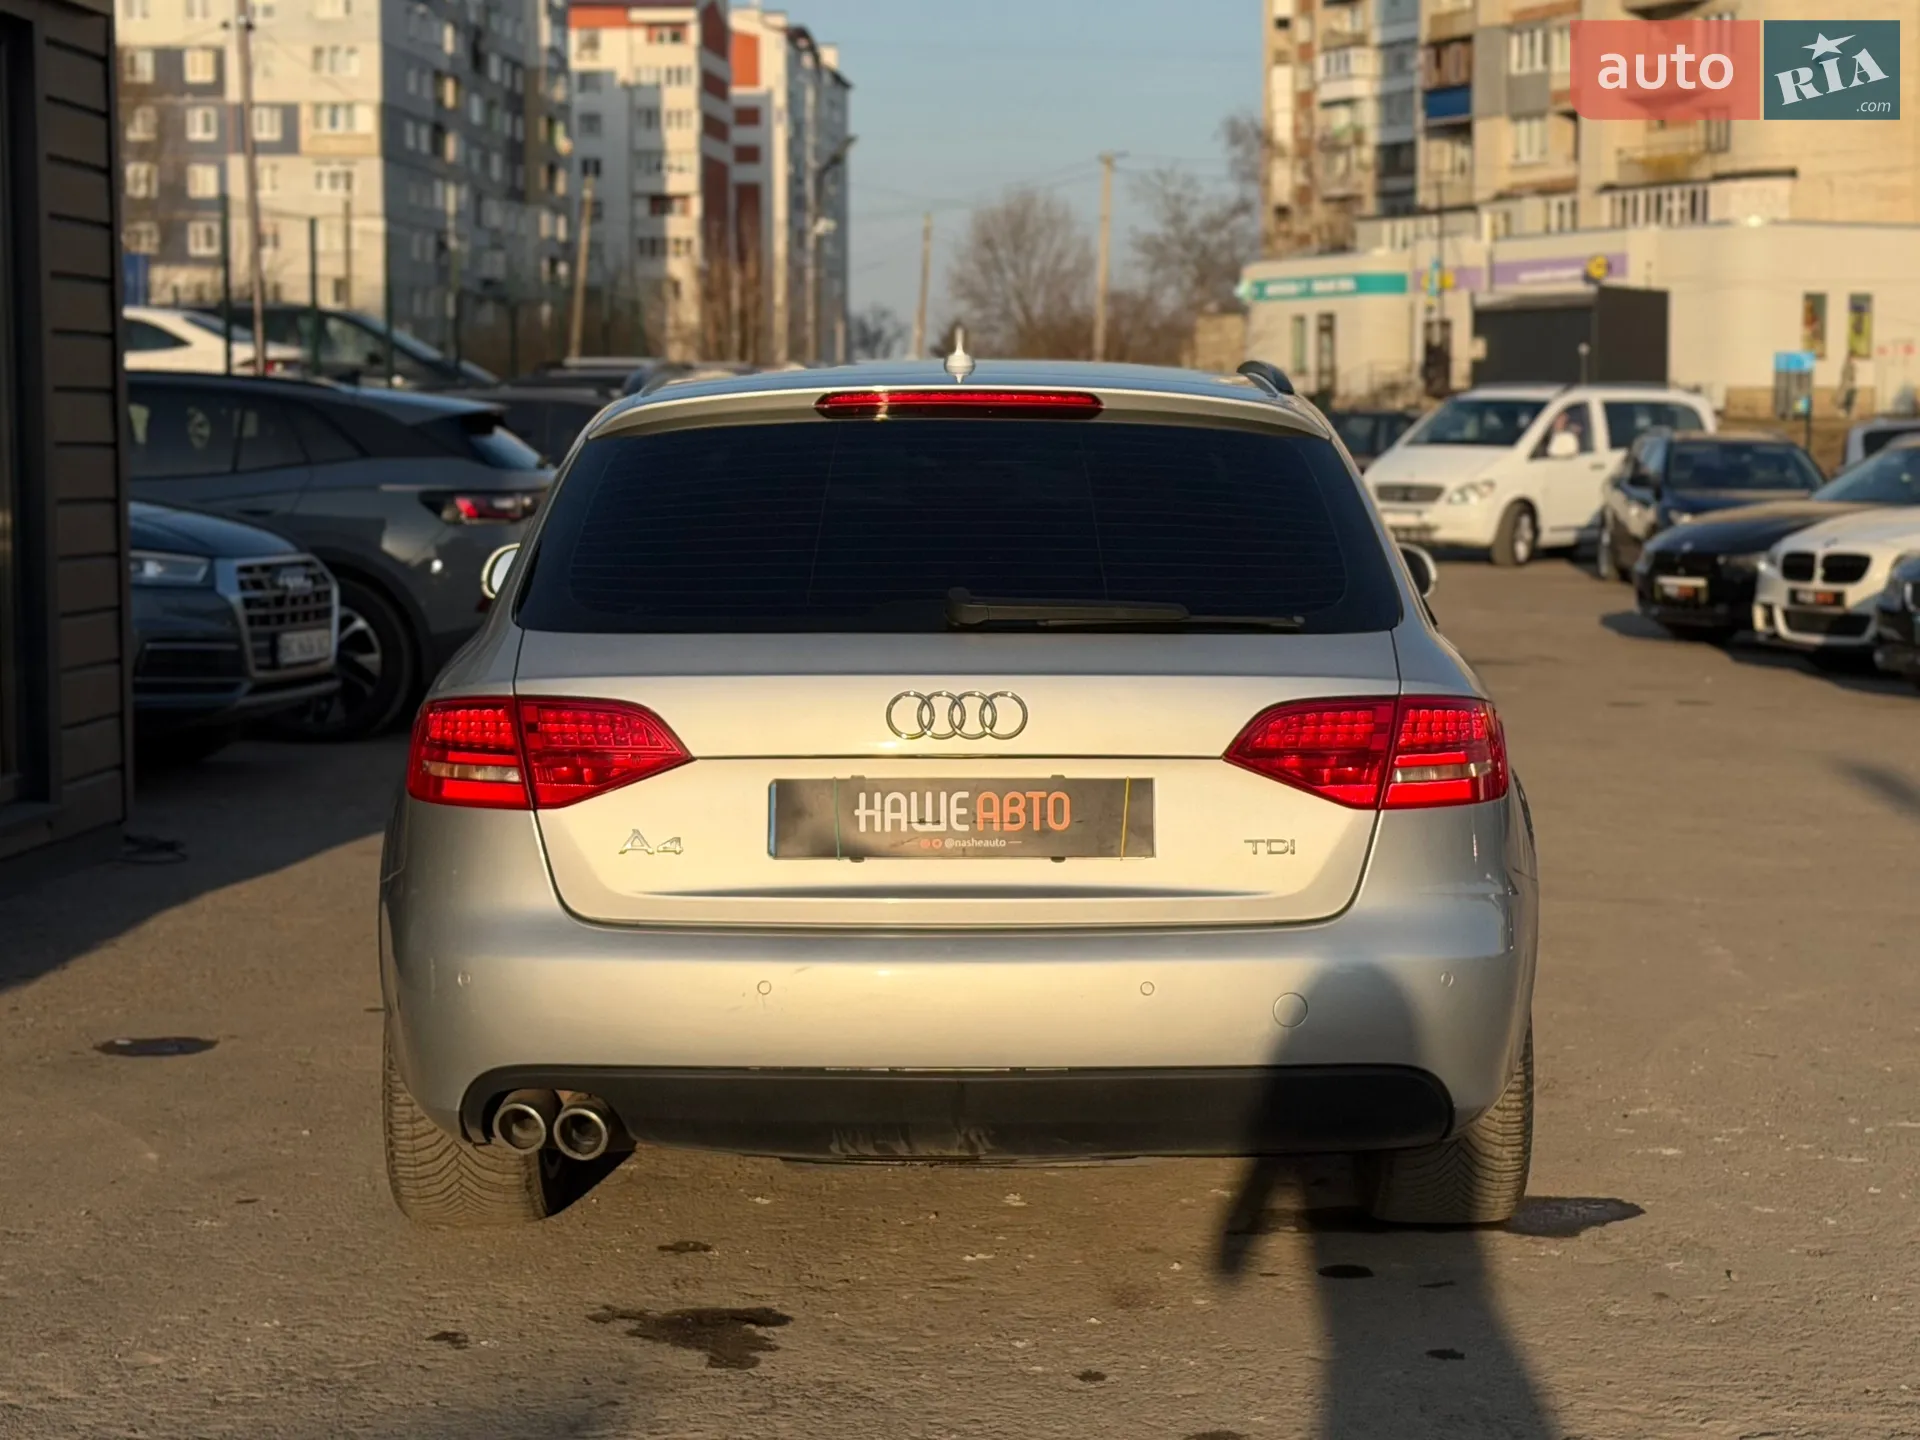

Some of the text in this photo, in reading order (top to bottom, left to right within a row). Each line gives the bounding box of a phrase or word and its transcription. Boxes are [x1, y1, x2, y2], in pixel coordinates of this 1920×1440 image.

[854, 791, 1071, 833] НАШЕ АВТО
[618, 828, 684, 855] A4
[944, 838, 1007, 849] @nasheauto
[1243, 838, 1296, 855] TDI
